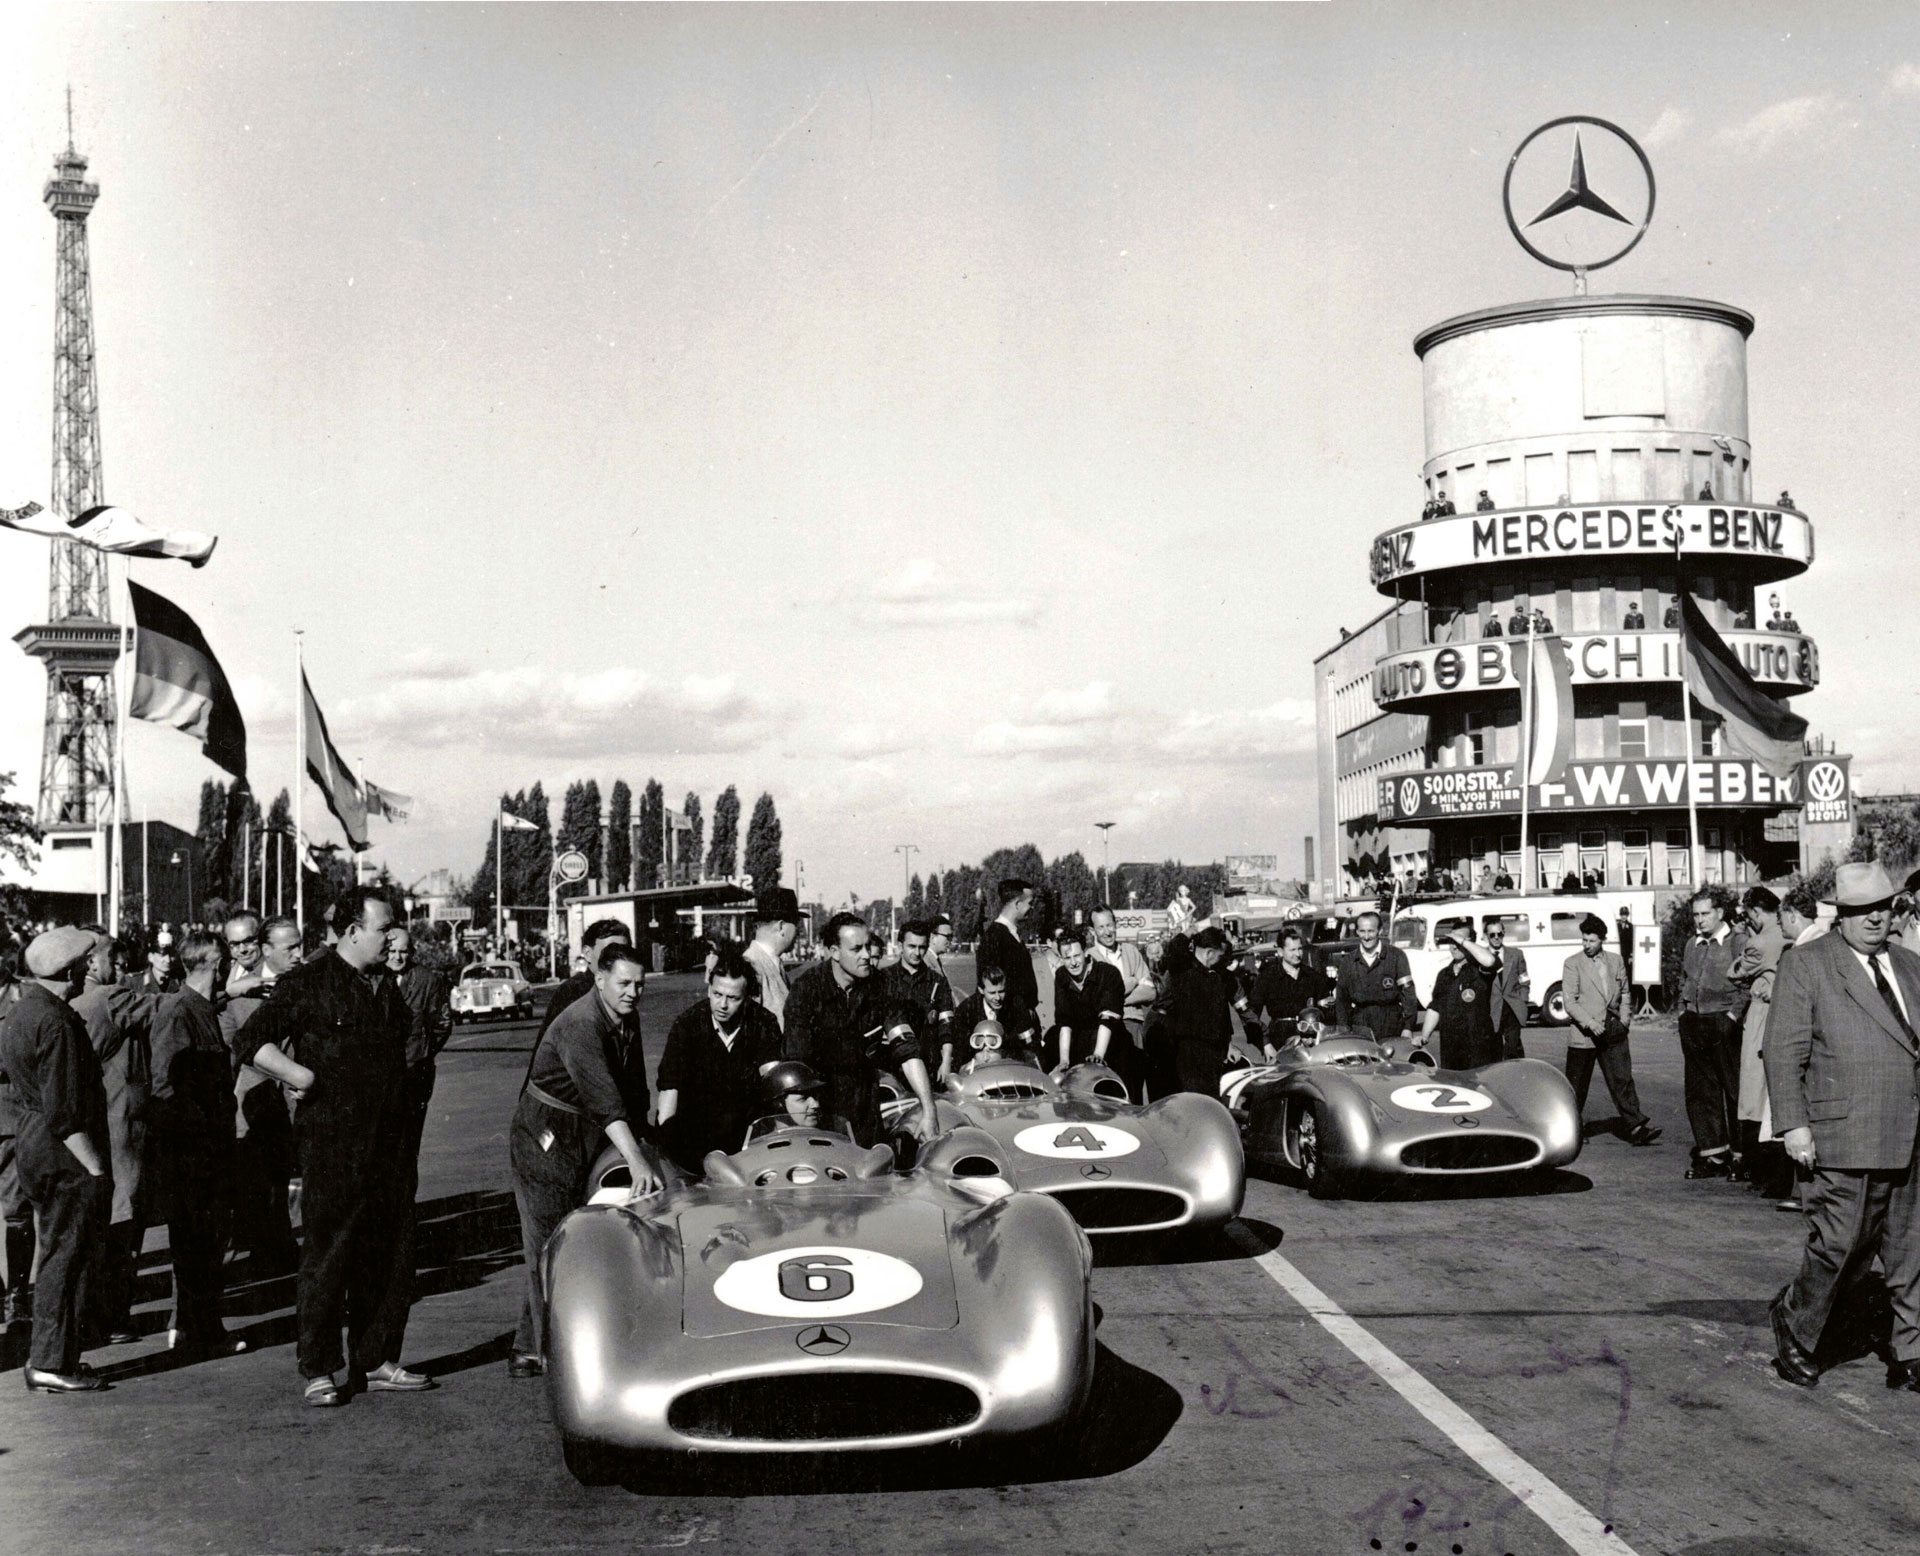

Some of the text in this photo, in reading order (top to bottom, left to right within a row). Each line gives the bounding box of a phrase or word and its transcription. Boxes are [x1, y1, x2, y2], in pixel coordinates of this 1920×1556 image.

[1472, 507, 1784, 558] MERCEDES-BENZ
[1423, 771, 1503, 795] SOORSTR.
[1492, 789, 1520, 800] HIER
[1807, 800, 1847, 811] DIENST
[1416, 1088, 1471, 1107] 2
[1053, 1127, 1107, 1151] 4
[778, 1254, 854, 1302] 6
